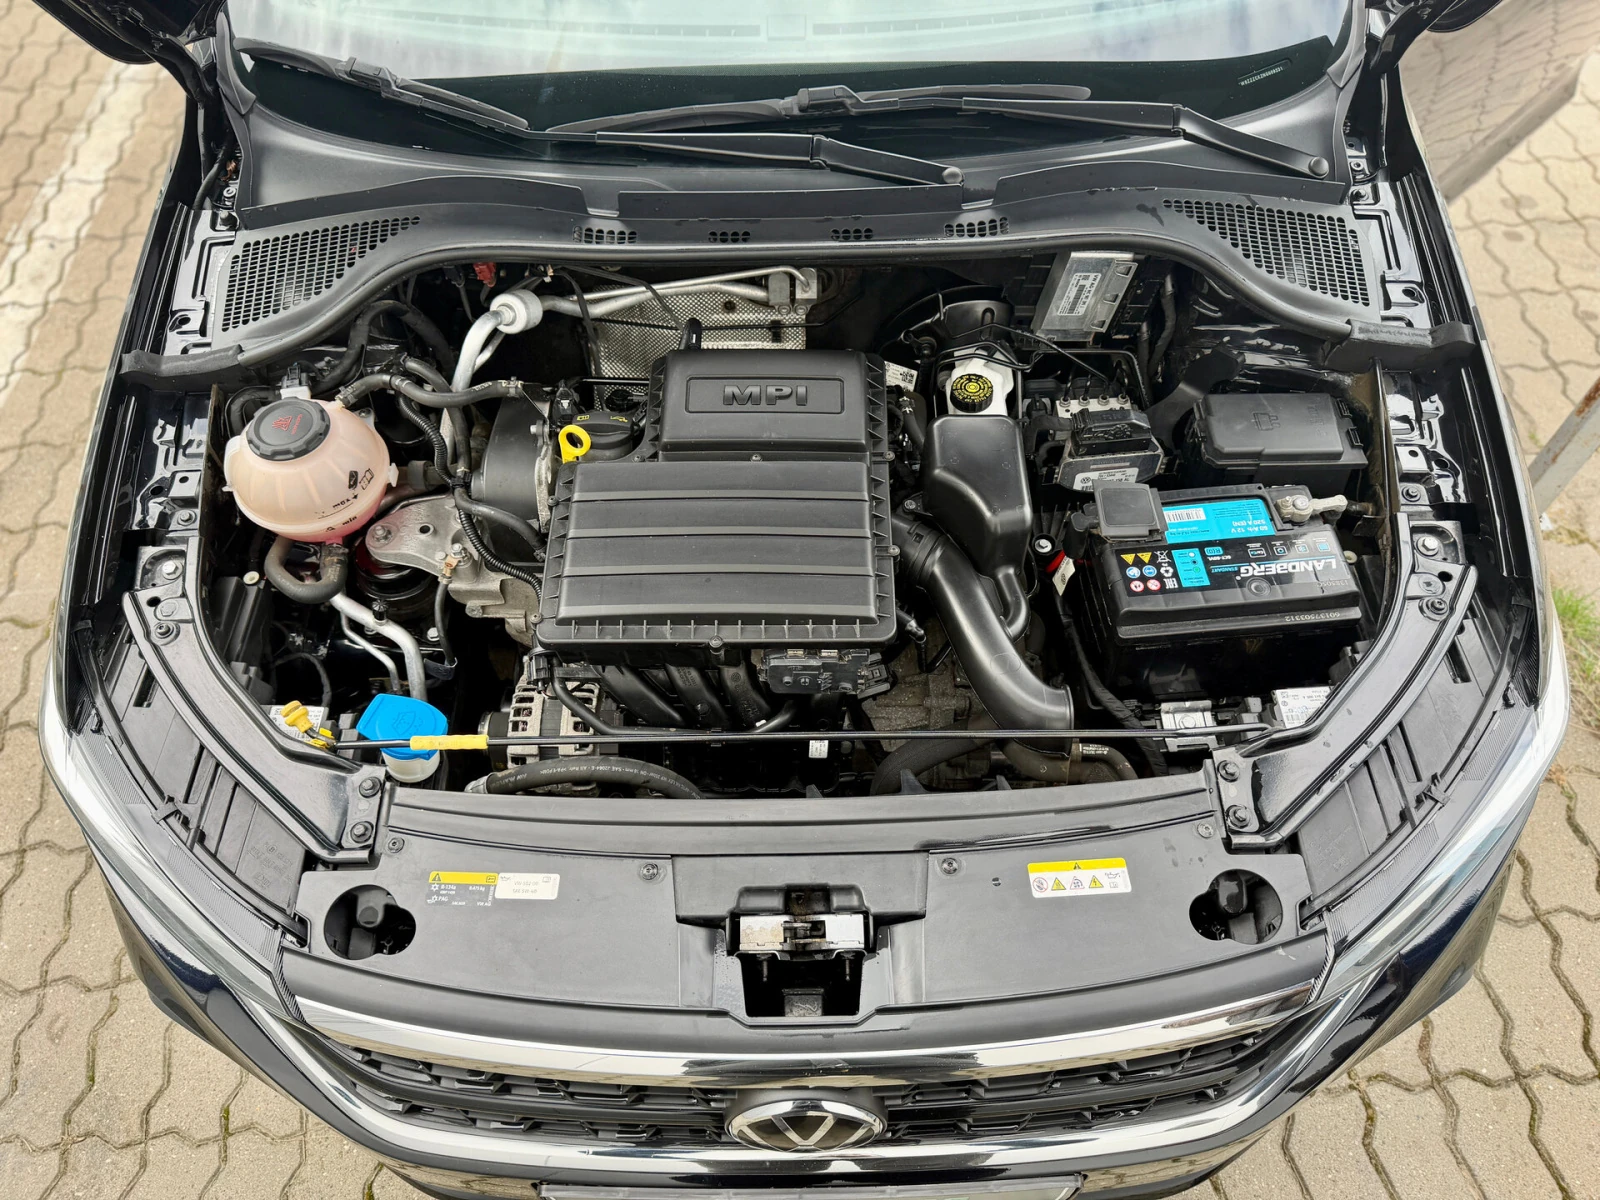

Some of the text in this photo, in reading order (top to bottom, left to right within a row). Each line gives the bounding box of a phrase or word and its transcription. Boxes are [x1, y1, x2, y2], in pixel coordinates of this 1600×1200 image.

[723, 385, 807, 406] MPI
[342, 515, 358, 525] min
[1239, 558, 1337, 578] LANDBERG
